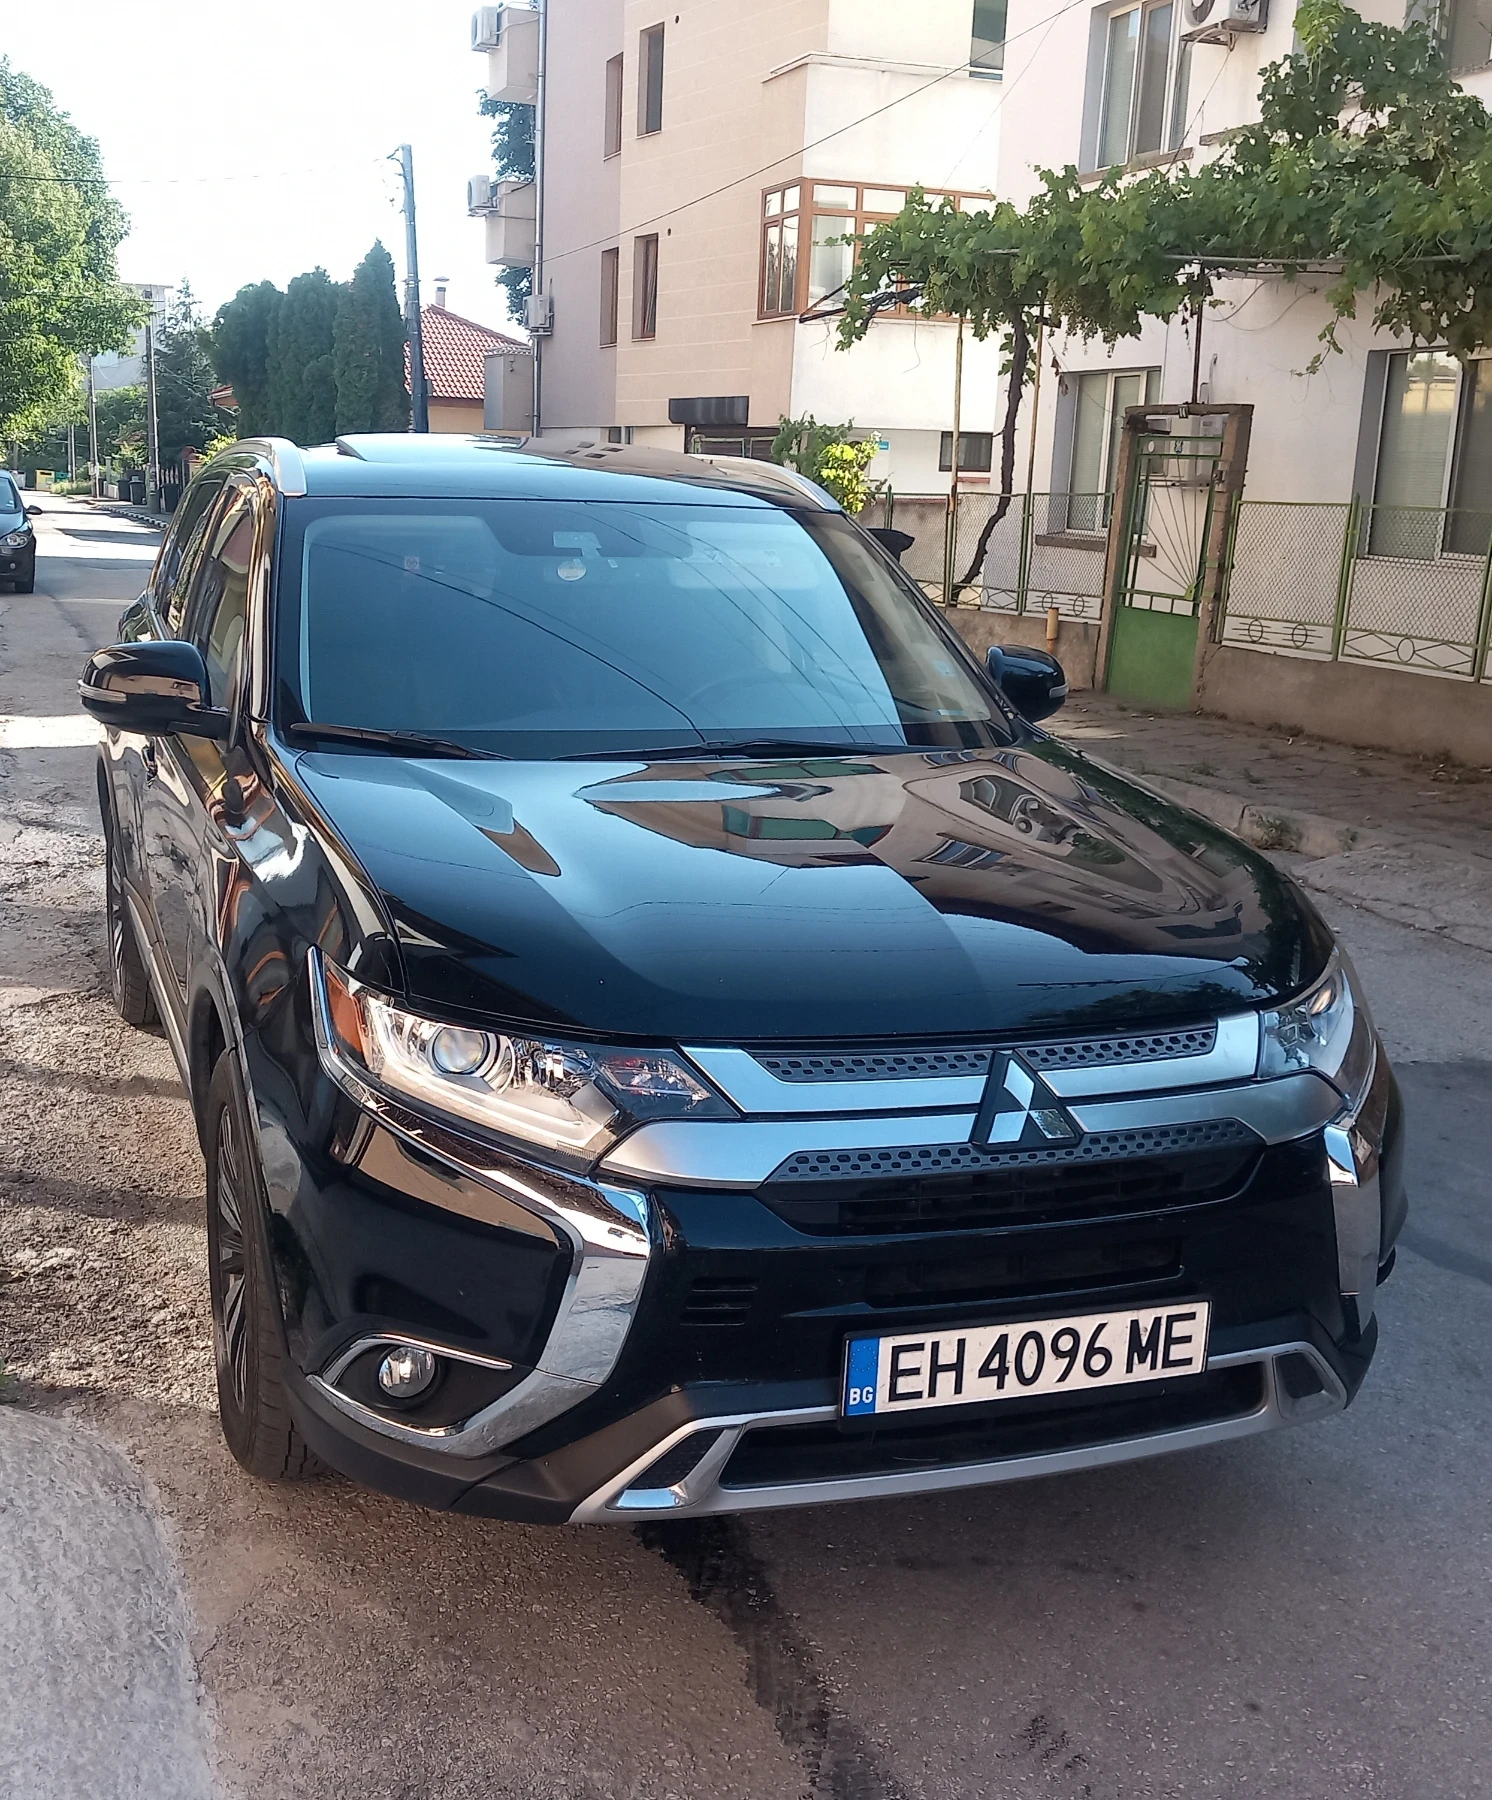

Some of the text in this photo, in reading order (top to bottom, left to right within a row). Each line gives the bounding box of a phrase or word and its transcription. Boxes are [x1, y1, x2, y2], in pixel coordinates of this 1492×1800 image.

[888, 1311, 1196, 1402] EH 4096 ME
[849, 1387, 873, 1406] BG
